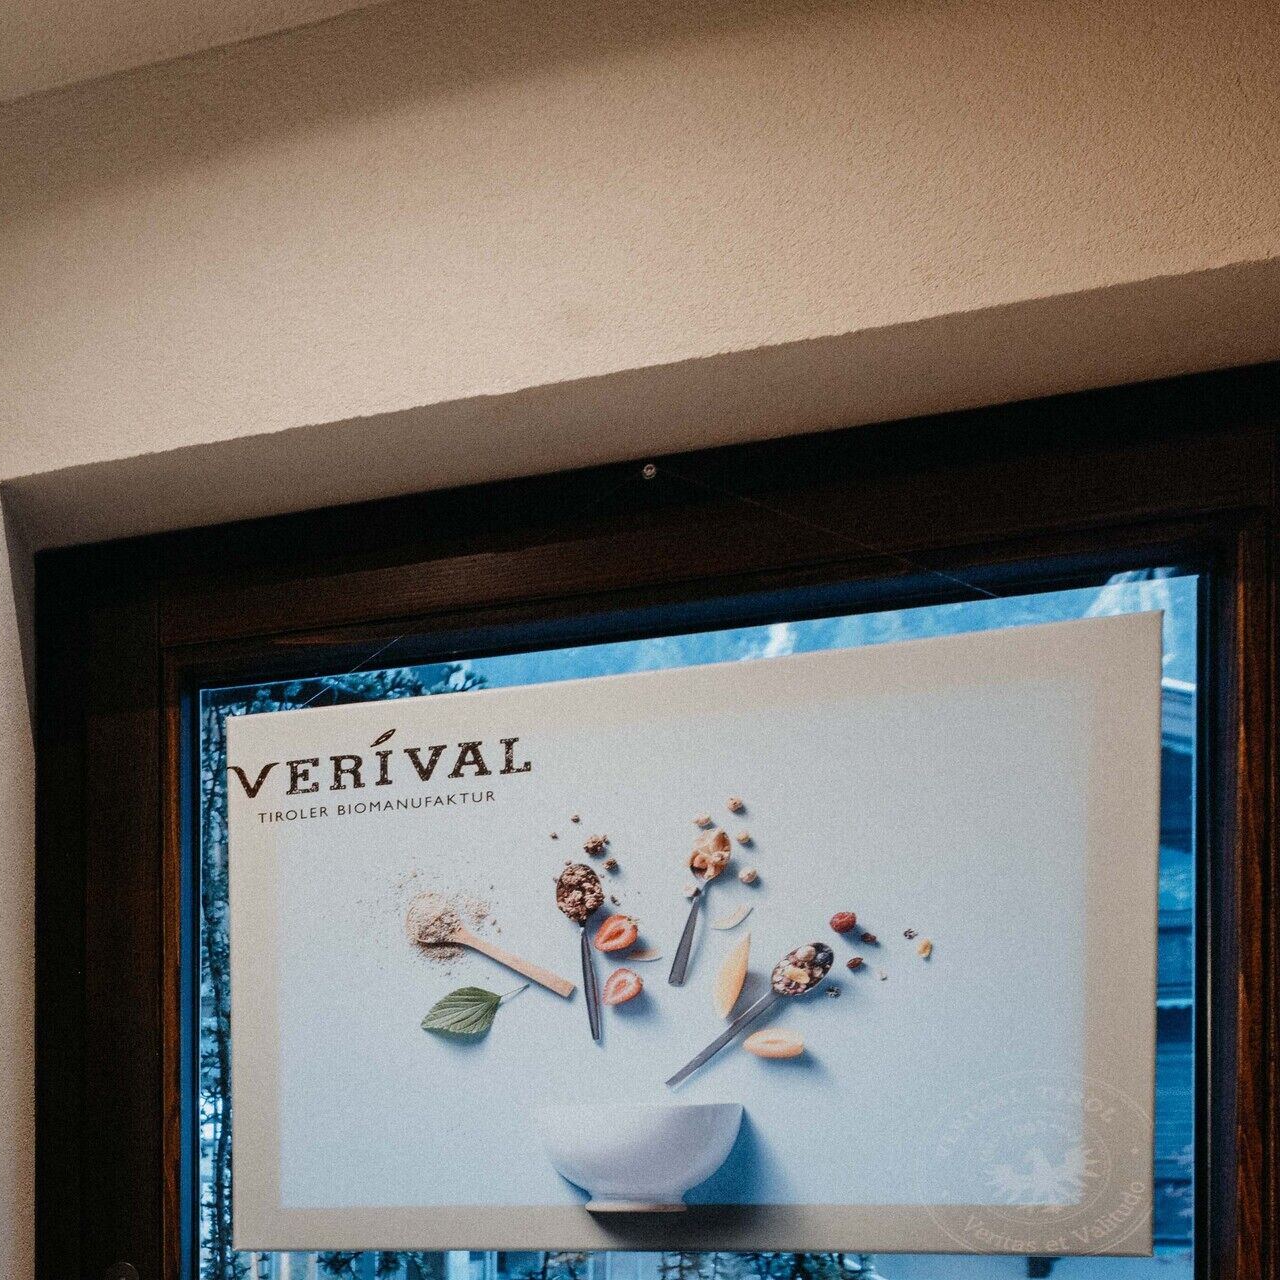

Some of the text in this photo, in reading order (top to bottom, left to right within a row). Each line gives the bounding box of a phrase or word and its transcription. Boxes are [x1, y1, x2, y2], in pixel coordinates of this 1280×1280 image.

[227, 728, 532, 799] VERÍVAL
[258, 790, 497, 824] TIROLER BIOMANUFAKTUR
[1045, 1235, 1070, 1252] et
